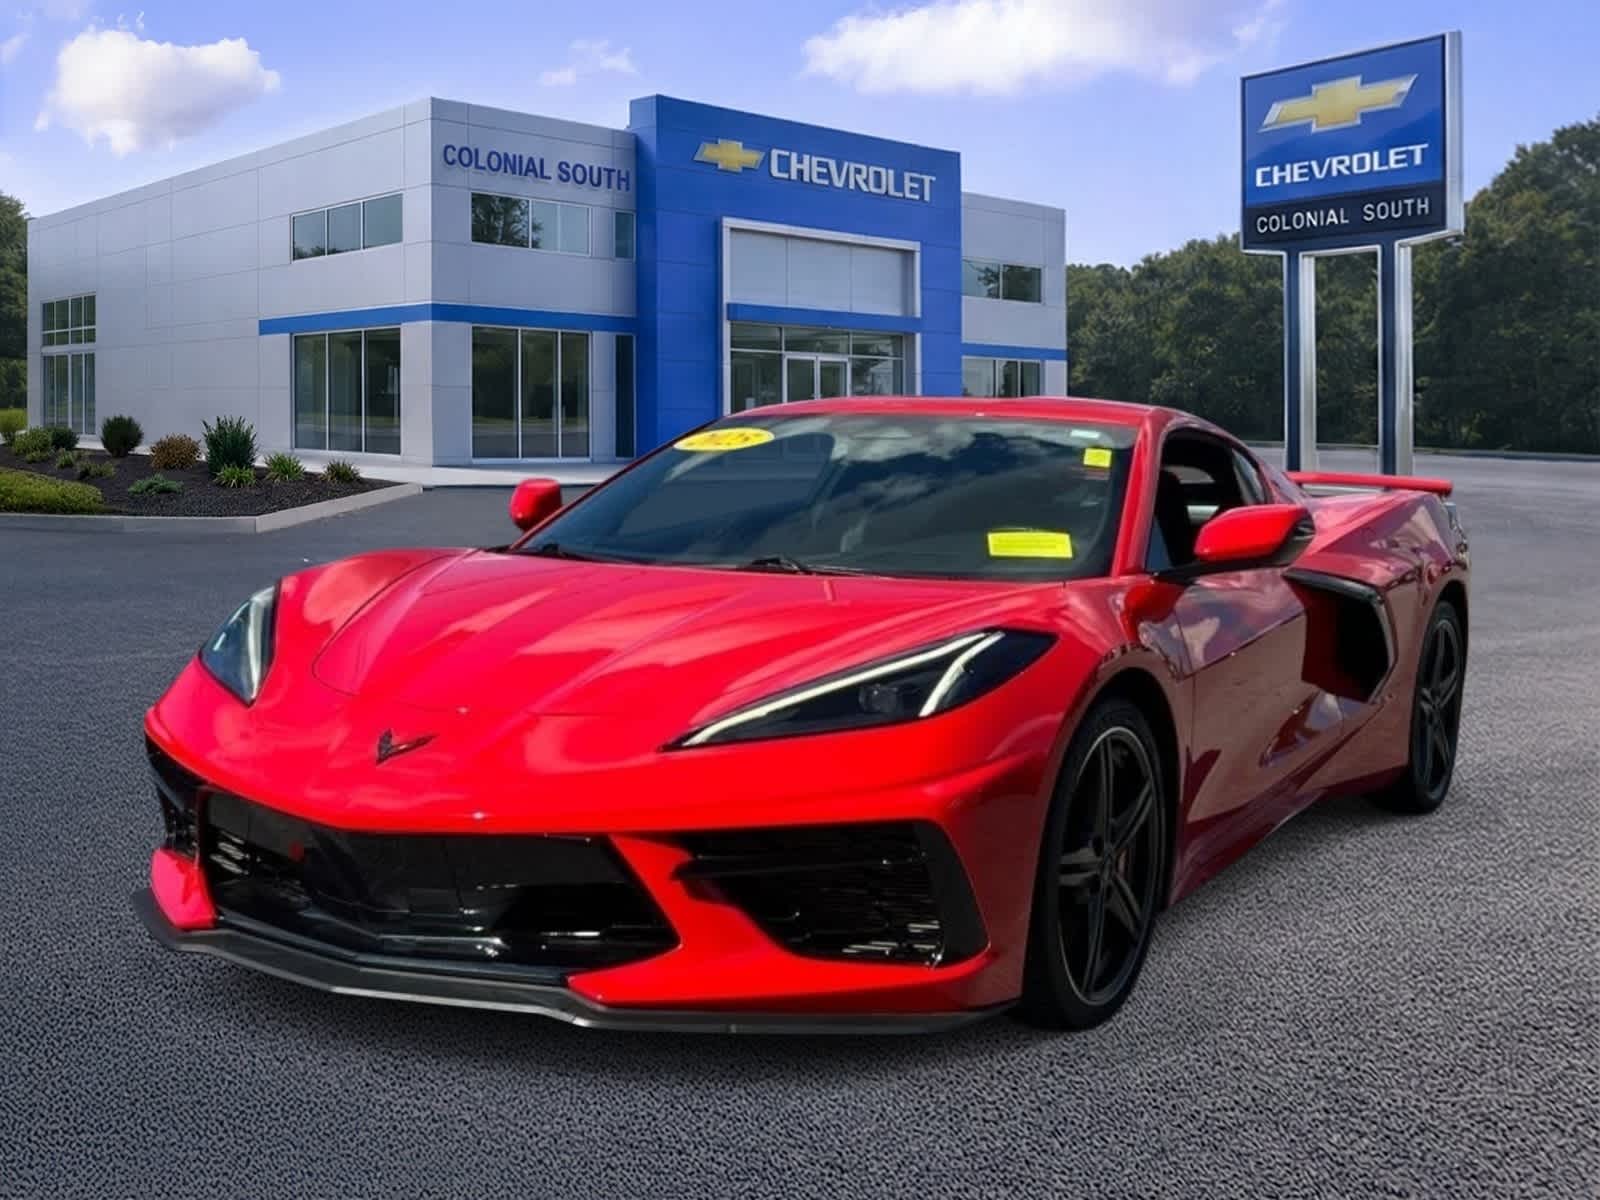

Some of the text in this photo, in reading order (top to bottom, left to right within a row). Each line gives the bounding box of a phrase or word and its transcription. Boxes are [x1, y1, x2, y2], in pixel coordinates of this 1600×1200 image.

[443, 144, 630, 192] COLONIAL SOUTH
[770, 148, 936, 203] CHEVROLET
[1255, 143, 1428, 188] CHEVROLET
[1256, 196, 1430, 234] COLONIAL SOUTH
